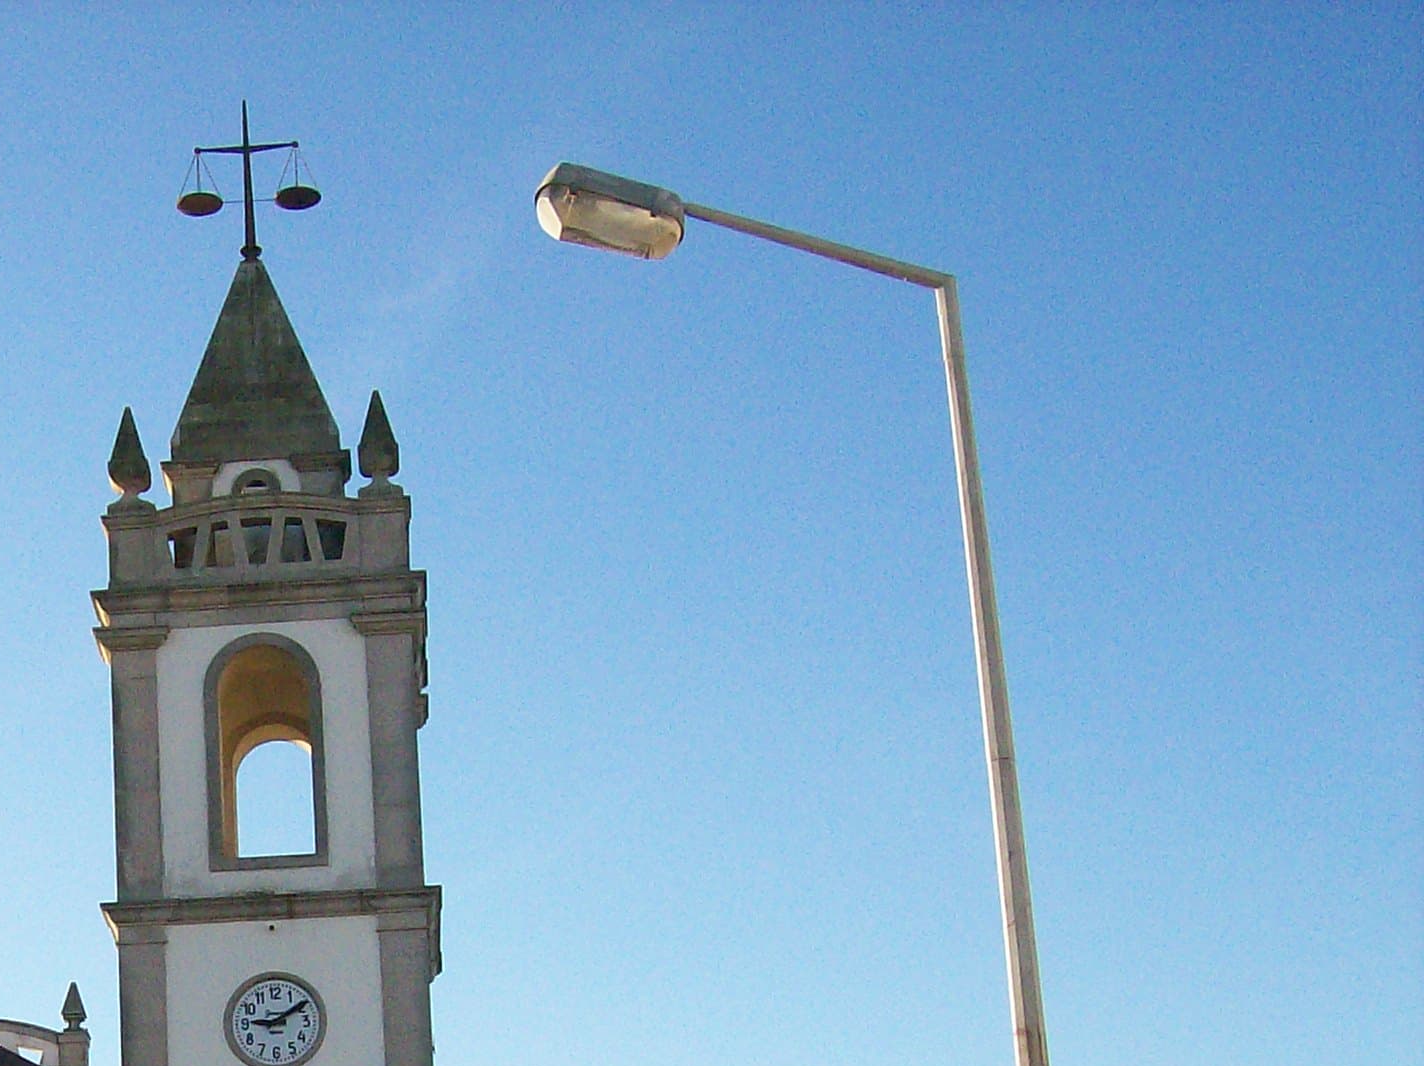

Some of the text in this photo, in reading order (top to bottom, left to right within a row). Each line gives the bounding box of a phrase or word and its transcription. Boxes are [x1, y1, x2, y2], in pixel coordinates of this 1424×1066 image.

[255, 992, 265, 1004] 11
[269, 987, 282, 1000] 12
[287, 991, 293, 1003] 1
[244, 1002, 256, 1016] 10
[241, 1018, 250, 1031] 9
[303, 1015, 311, 1028] 3
[246, 1033, 254, 1046] 8
[297, 1030, 306, 1043] 4
[257, 1043, 266, 1056] 7
[272, 1046, 281, 1059] 6
[288, 1042, 297, 1055] 5
